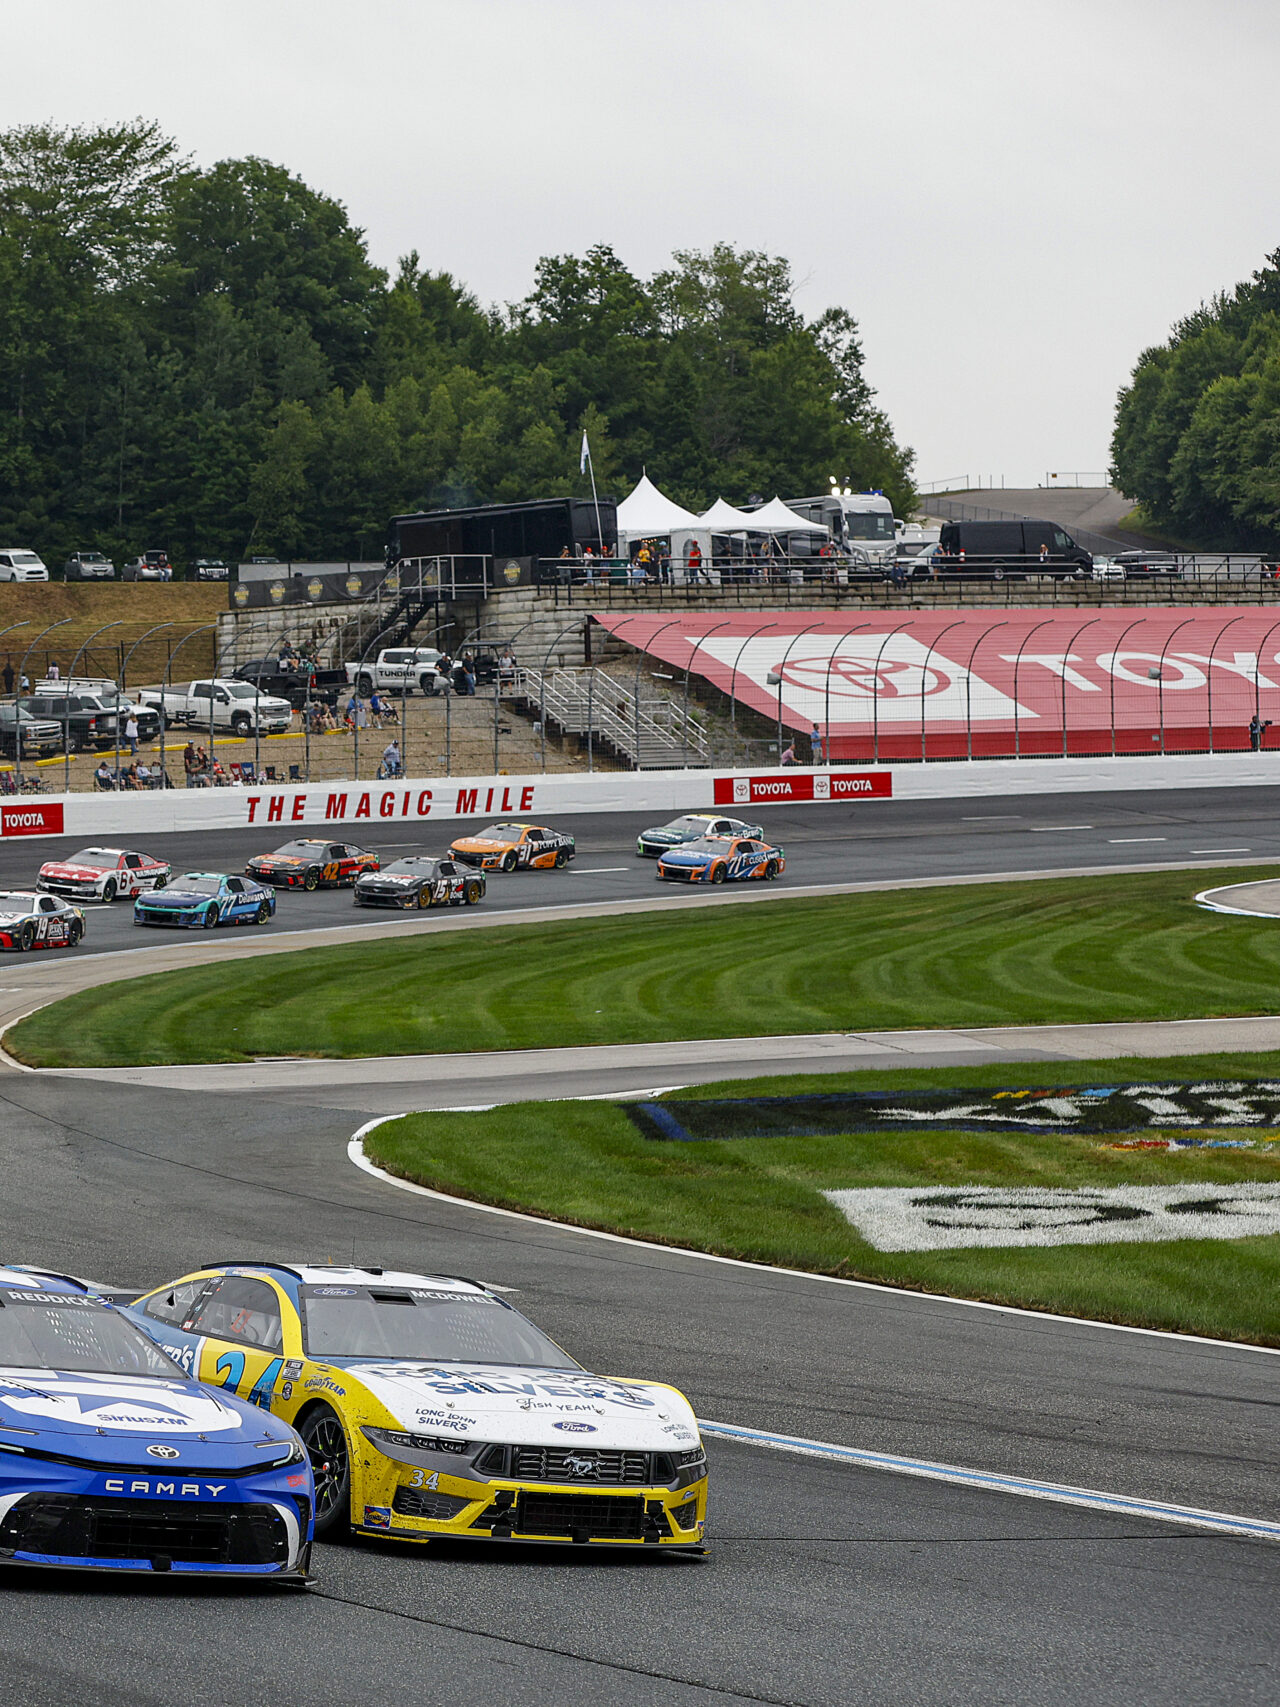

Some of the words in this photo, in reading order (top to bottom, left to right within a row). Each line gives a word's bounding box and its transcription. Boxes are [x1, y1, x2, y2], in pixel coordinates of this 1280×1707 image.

[378, 670, 416, 678] TUNDRA
[998, 650, 1280, 692] TOY
[752, 782, 793, 797] TOYOTA
[832, 779, 873, 793] TOYOTA
[247, 794, 307, 823] THE
[325, 790, 432, 819] MAGIC
[455, 786, 534, 814] MILE
[4, 812, 44, 827] TOYOTA
[519, 844, 532, 861] 31
[323, 862, 339, 880] 42
[728, 856, 743, 874] 71
[120, 872, 128, 889] 6
[436, 880, 448, 898] 15
[220, 894, 237, 916] 77
[36, 918, 48, 939] 19
[8, 1291, 96, 1308] REDDICK
[410, 1290, 500, 1306] MCDOWELL
[304, 1376, 346, 1397] GOODYEAR
[96, 1412, 188, 1427] SiriusXM
[415, 1407, 445, 1419] LONG
[446, 1413, 476, 1425] JOHN
[418, 1417, 470, 1432] SILVER'S
[105, 1478, 226, 1496] CAMRY
[409, 1469, 439, 1490] 34
